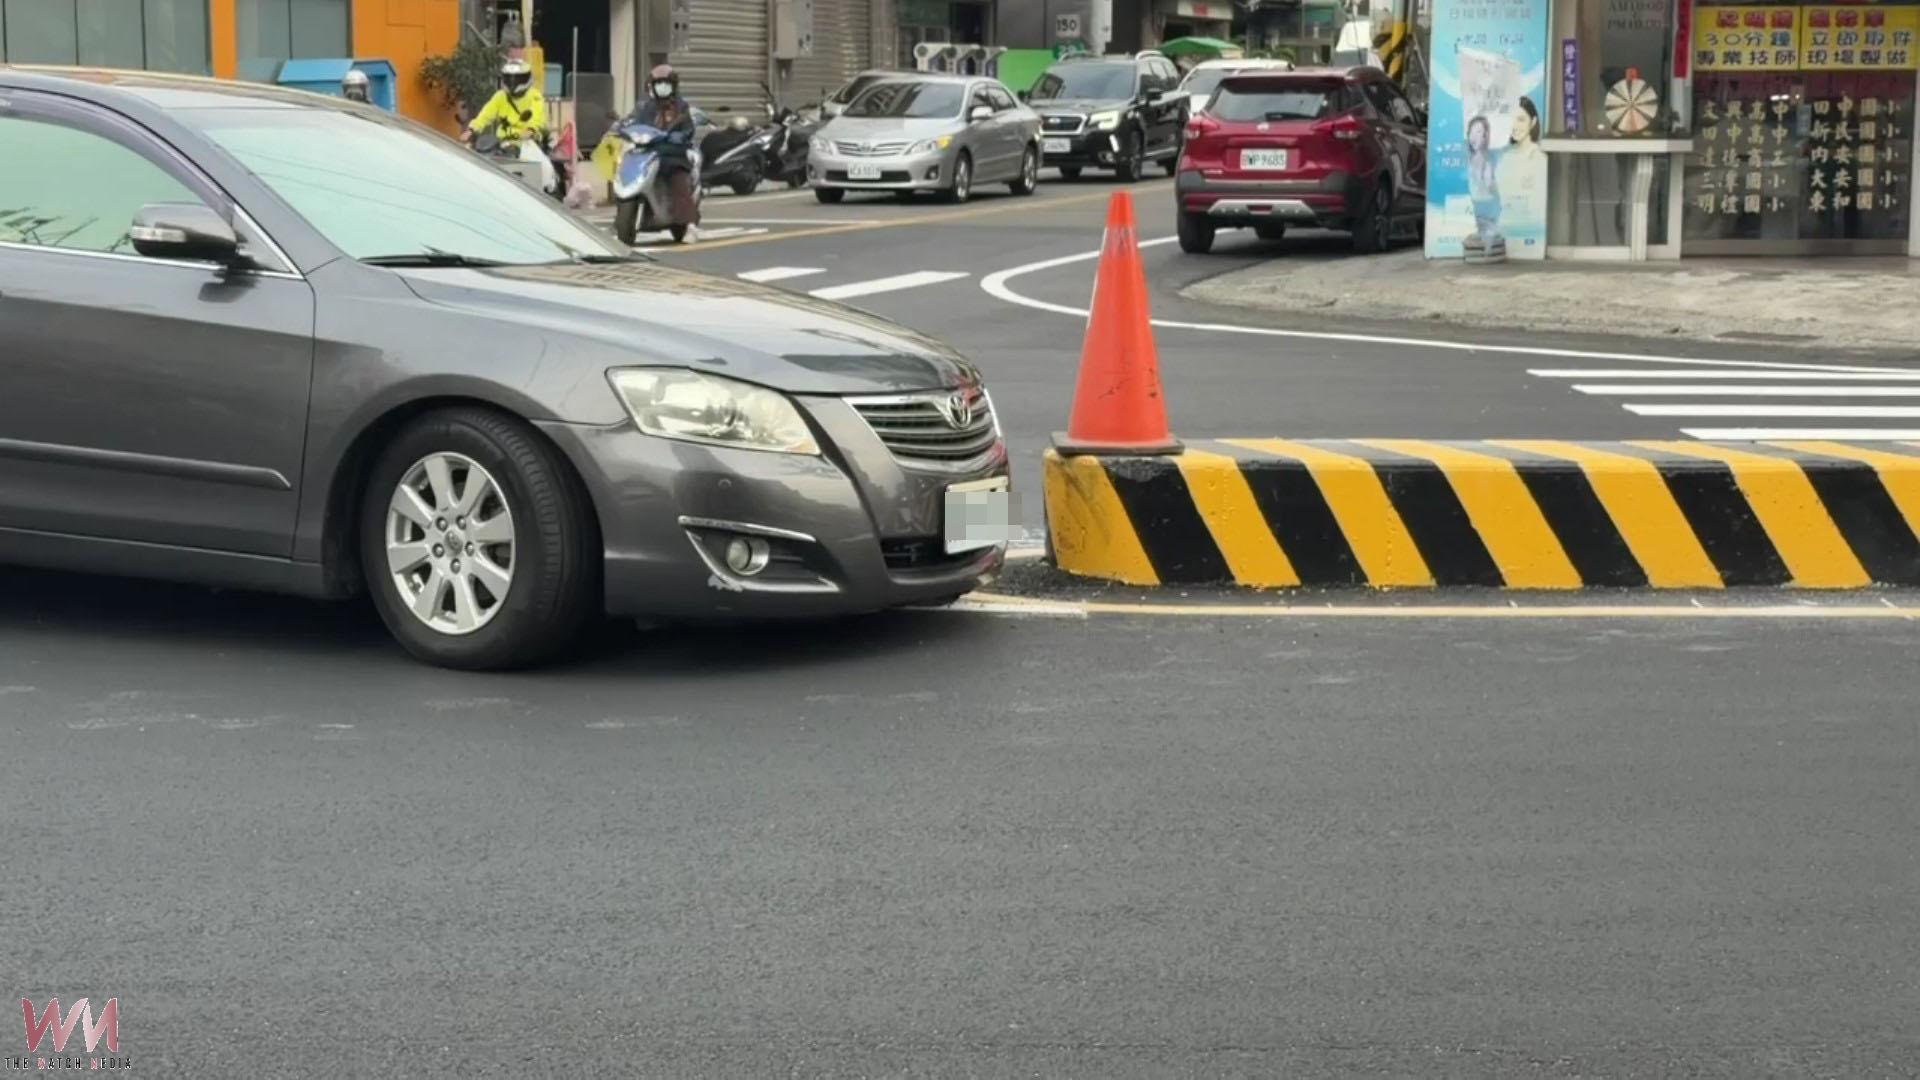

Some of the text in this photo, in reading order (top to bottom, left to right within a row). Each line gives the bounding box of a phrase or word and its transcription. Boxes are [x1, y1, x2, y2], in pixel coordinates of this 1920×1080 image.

[1056, 18, 1077, 32] 150
[1697, 49, 1796, 66] 專業技師
[1703, 101, 1789, 121] 文興高中
[1814, 96, 1902, 118] 田中國小
[1702, 123, 1788, 145] 田中高中
[1810, 168, 1898, 188] 大安國小
[1808, 191, 1897, 212] 東和國小
